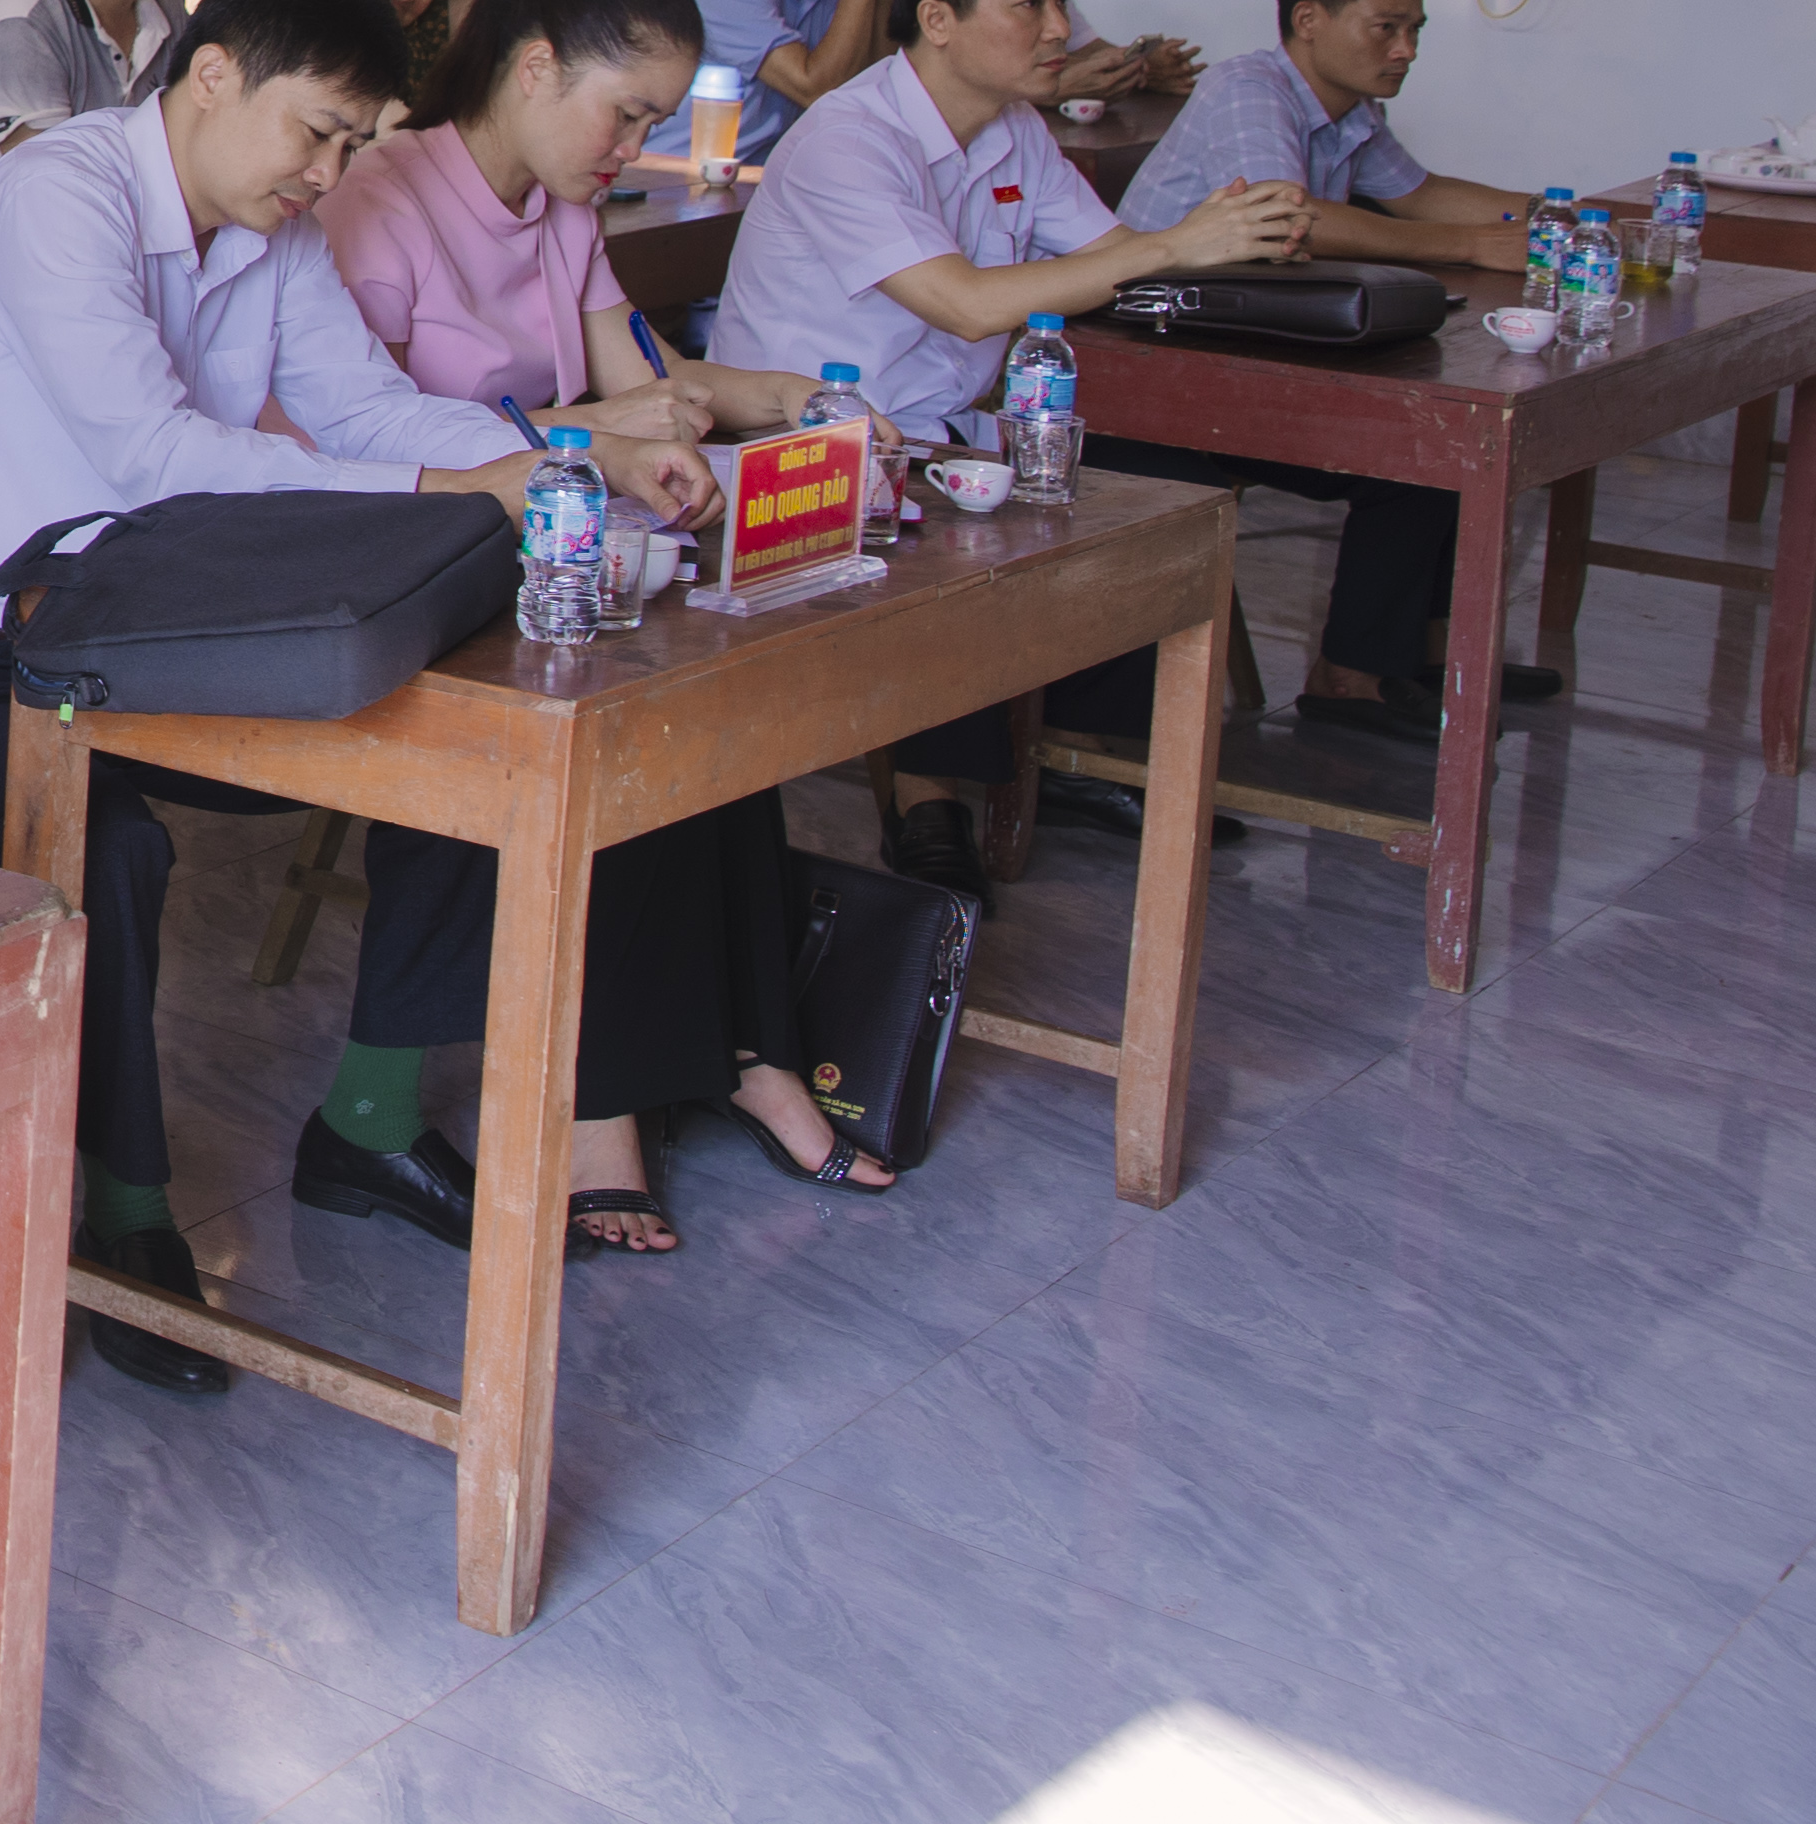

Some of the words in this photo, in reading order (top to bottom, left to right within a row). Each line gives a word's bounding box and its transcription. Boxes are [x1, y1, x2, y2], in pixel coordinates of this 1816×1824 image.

[779, 445, 807, 472] ĐỒNG
[809, 439, 826, 464] CHÍ
[745, 491, 774, 529] ĐÀO
[777, 484, 820, 523] QUANG
[822, 468, 849, 509] BẢO
